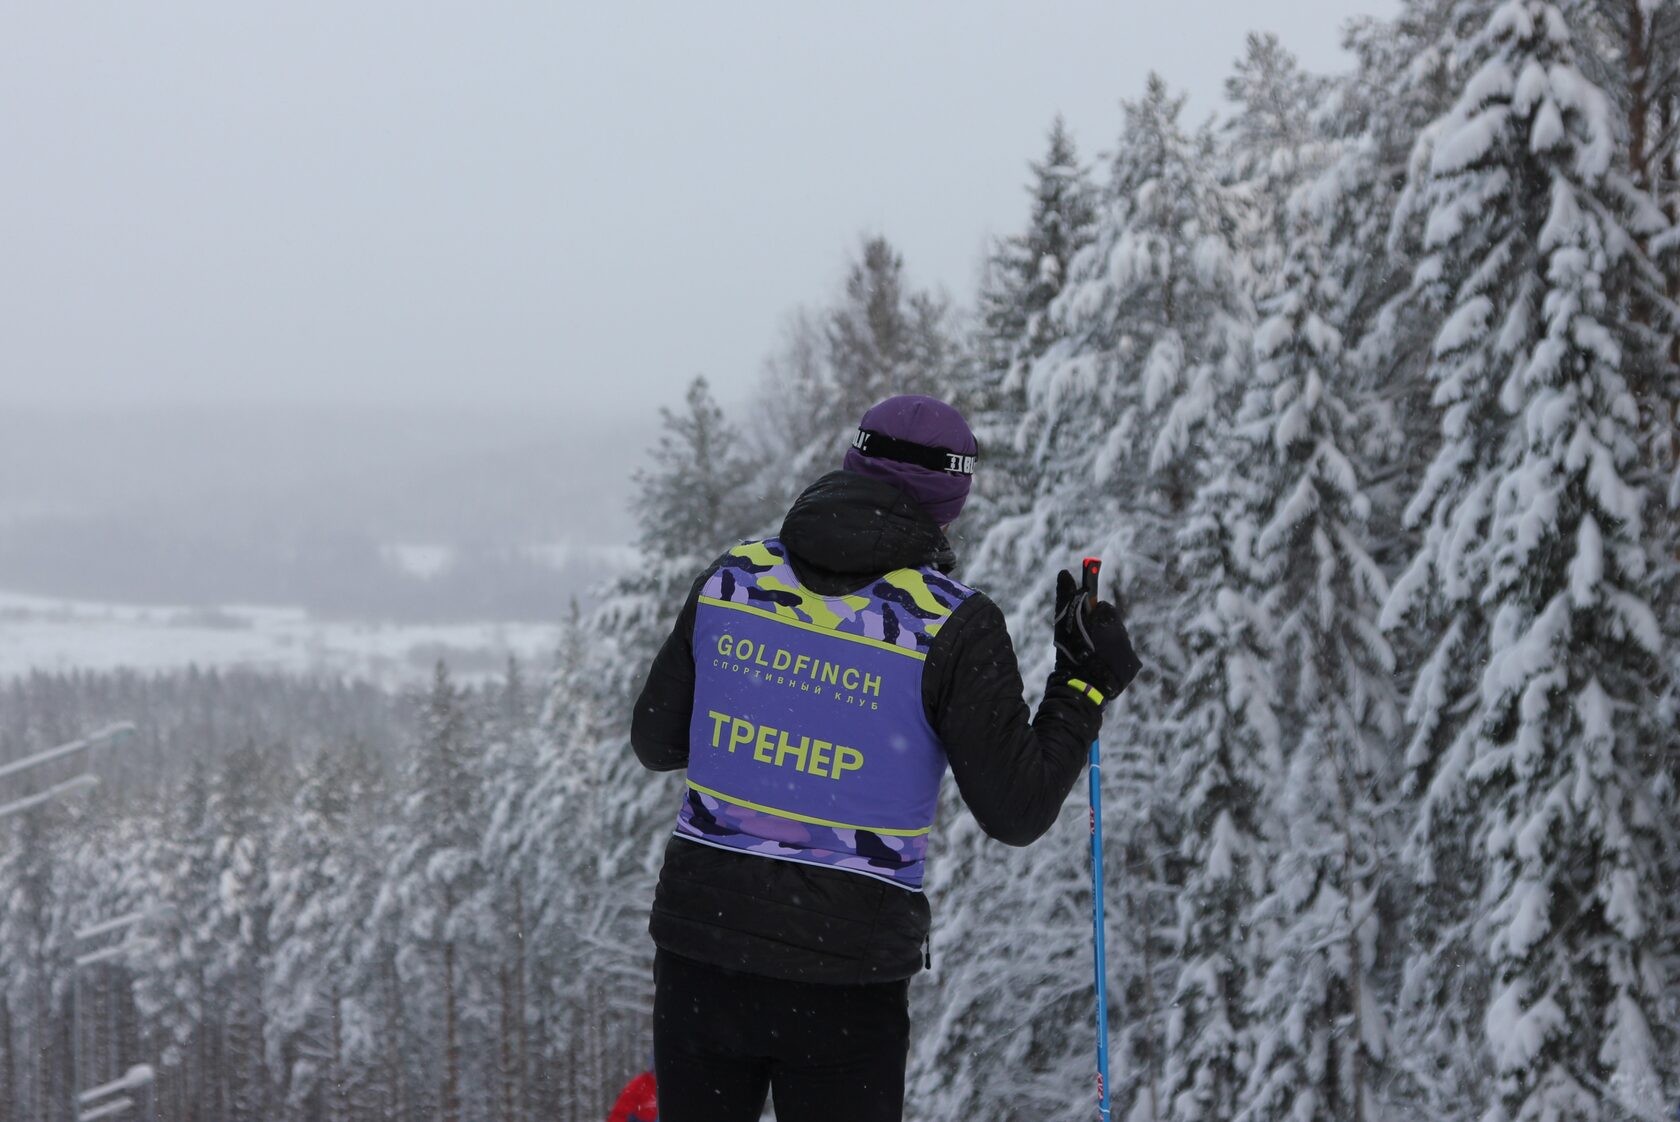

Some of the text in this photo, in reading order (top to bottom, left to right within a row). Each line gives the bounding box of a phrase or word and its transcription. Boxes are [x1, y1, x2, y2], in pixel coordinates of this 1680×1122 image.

[713, 659, 879, 711] СПОРТИВНЫЙ КЛУБ
[717, 634, 882, 697] GOLDFINCH
[708, 710, 865, 781] ТРЕНЕР
